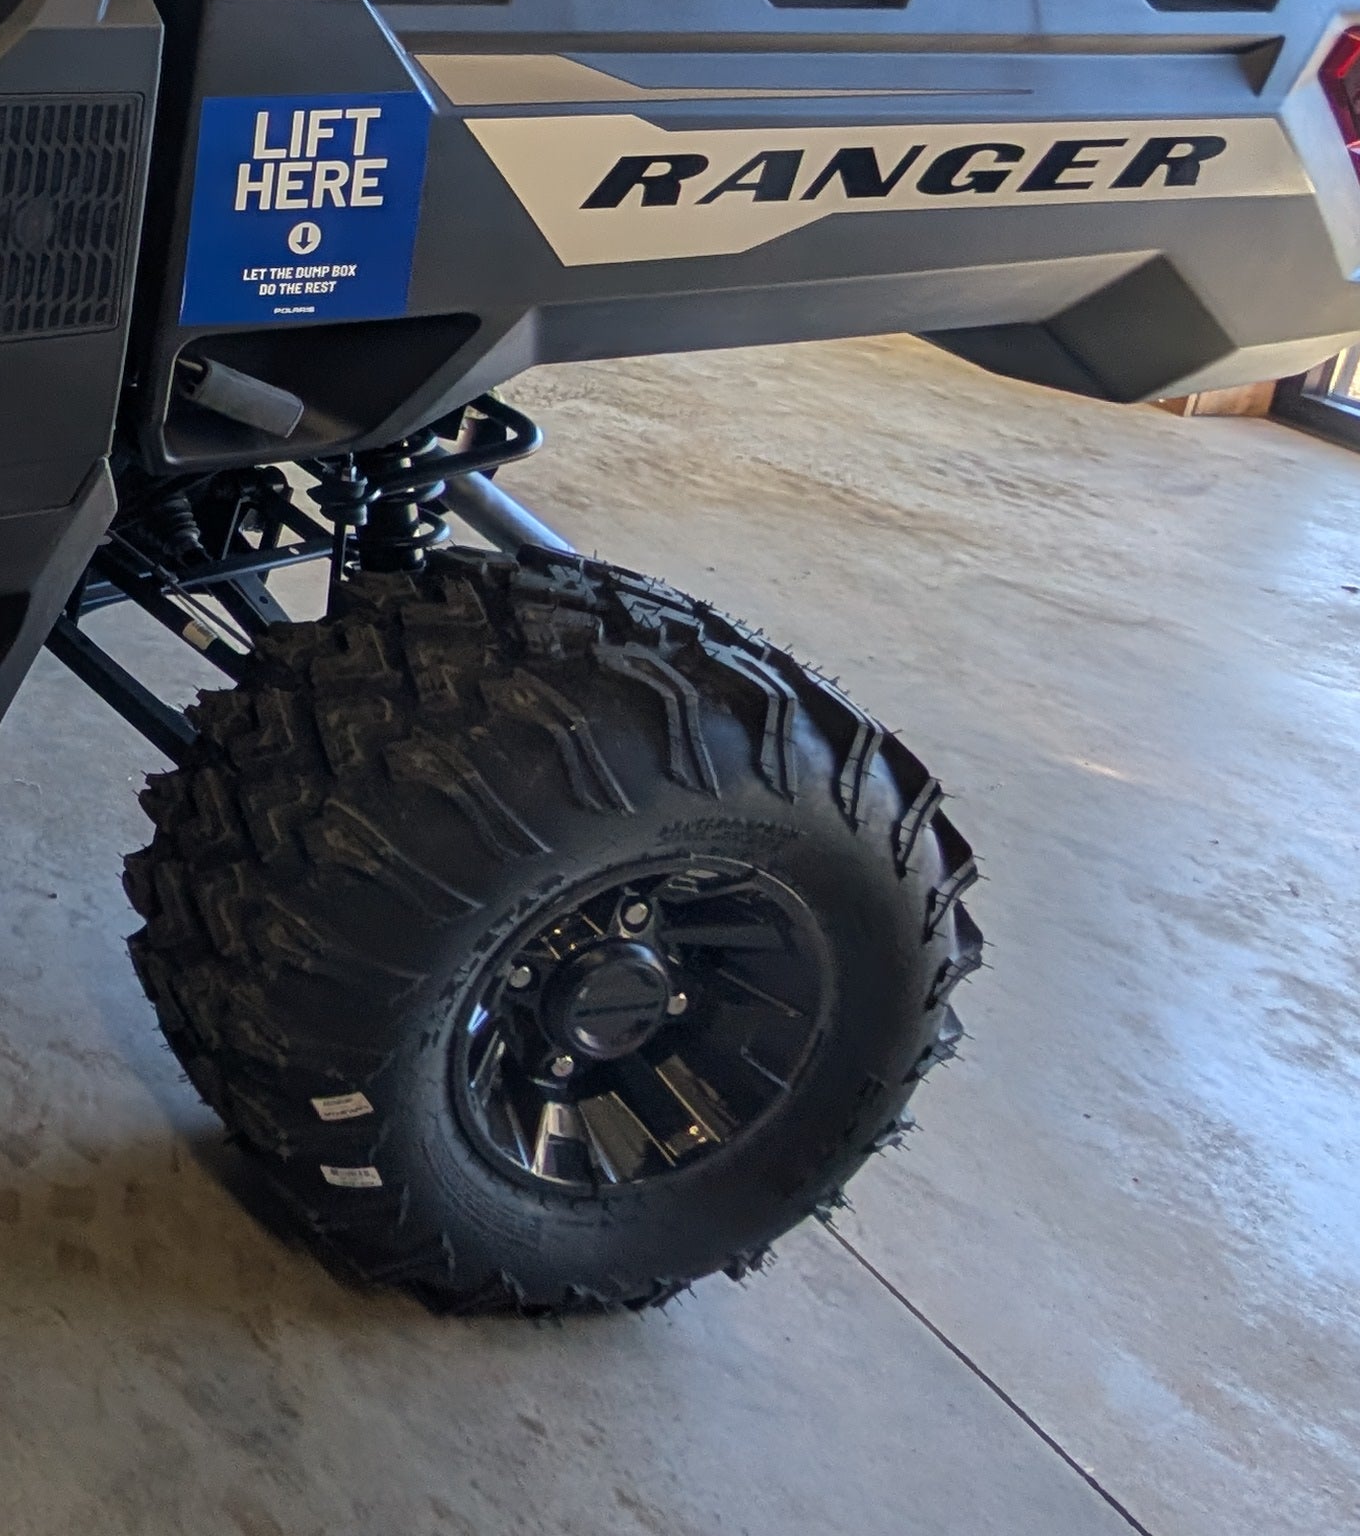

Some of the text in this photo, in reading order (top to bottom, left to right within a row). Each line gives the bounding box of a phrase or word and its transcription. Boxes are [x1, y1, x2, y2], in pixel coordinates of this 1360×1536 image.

[253, 108, 381, 159] LIFT
[235, 158, 388, 211] HERE
[579, 135, 1228, 210] RANGER
[243, 264, 357, 281] LET THE DUMP BOX
[259, 280, 337, 296] DO THE REST
[274, 305, 315, 314] POLARIS
